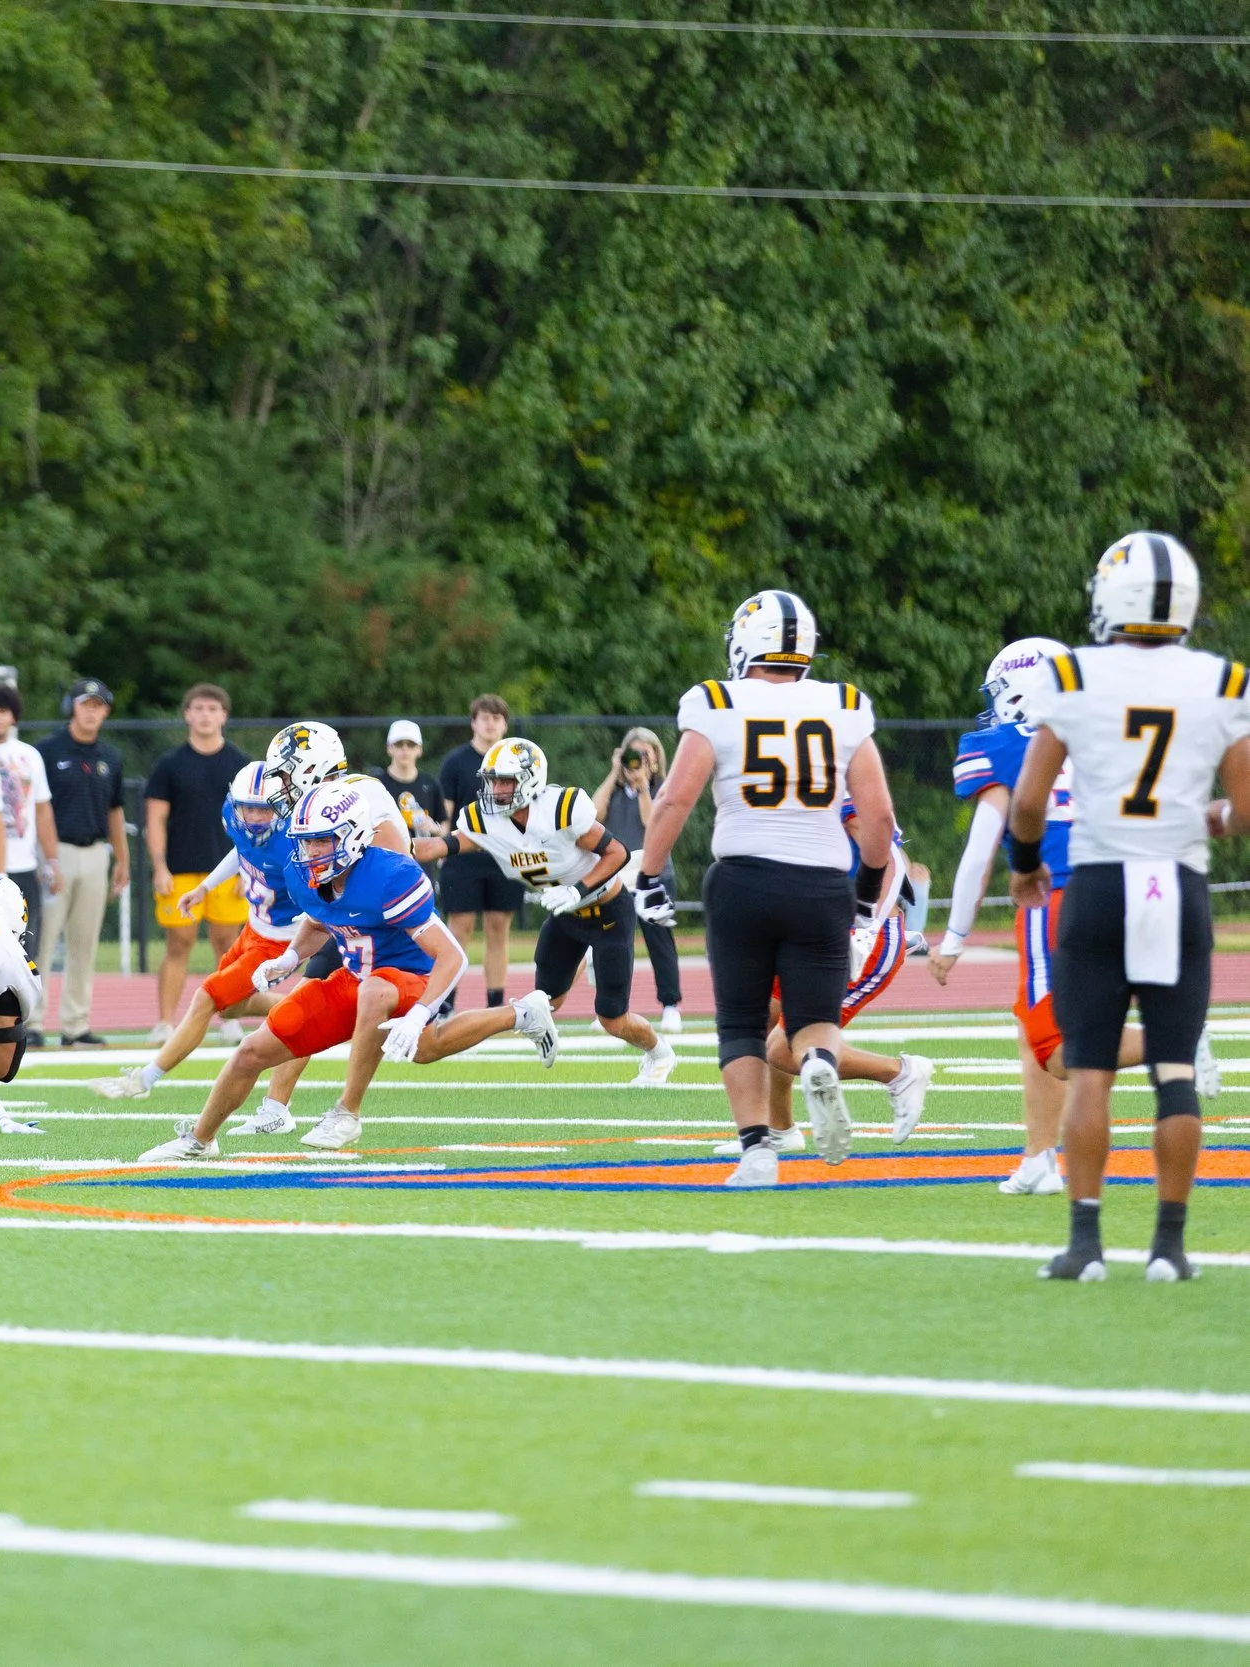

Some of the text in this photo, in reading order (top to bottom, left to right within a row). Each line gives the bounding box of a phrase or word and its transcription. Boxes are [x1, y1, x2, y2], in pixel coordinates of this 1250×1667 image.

[741, 718, 837, 809] 50
[1120, 706, 1176, 818] 7
[510, 852, 548, 868] NEERS
